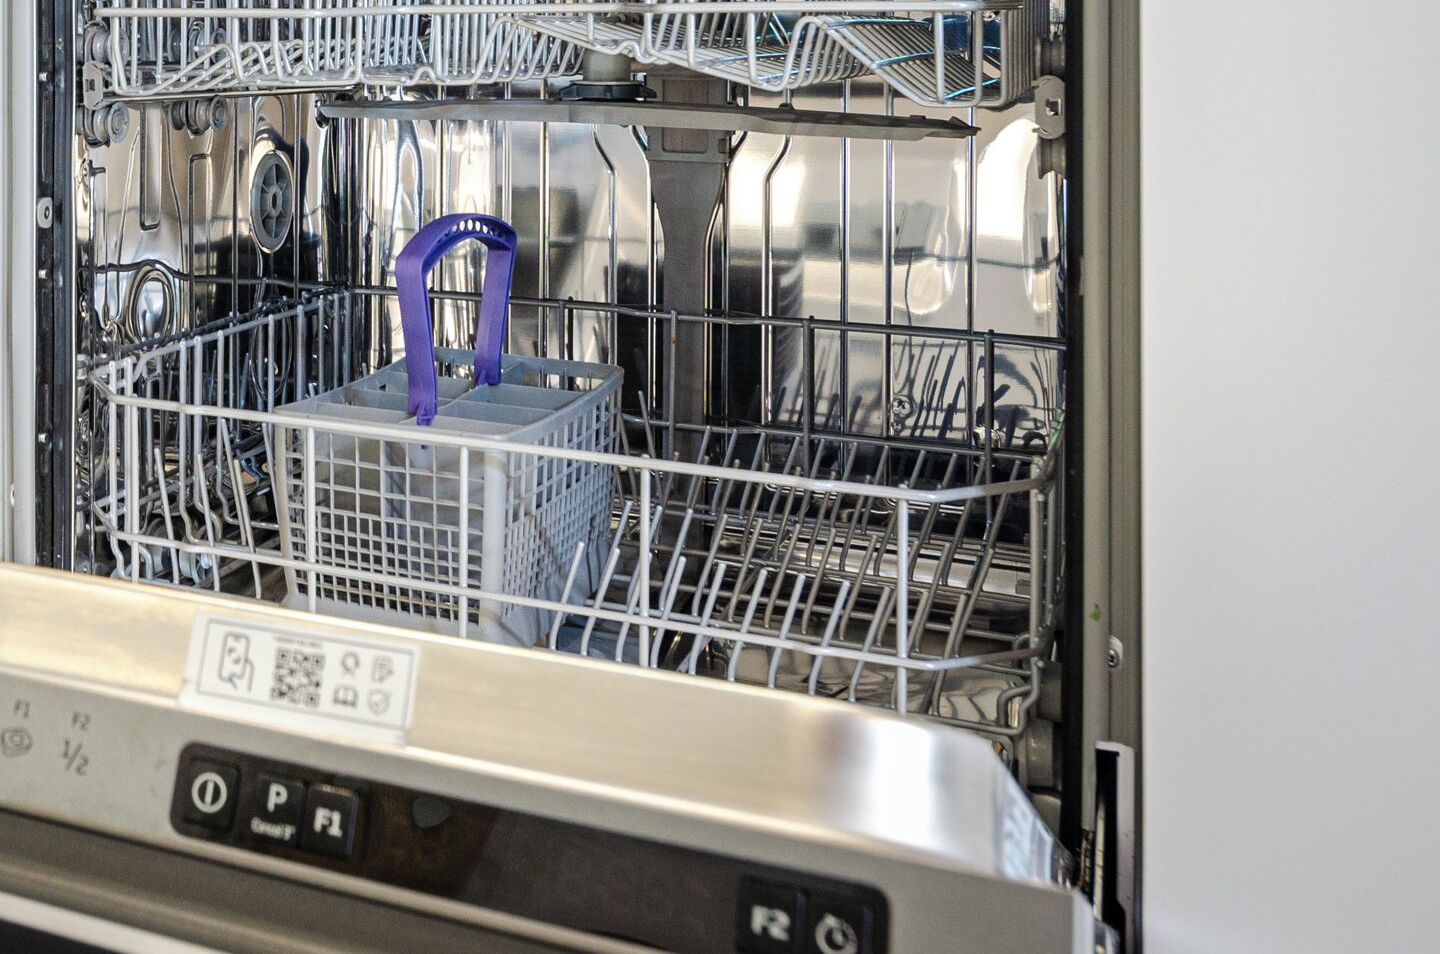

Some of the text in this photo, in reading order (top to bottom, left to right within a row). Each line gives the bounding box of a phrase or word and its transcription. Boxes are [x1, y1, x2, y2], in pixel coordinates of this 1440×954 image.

[13, 699, 30, 719] F1
[71, 710, 91, 732] F2
[62, 738, 89, 776] 1/2
[266, 782, 288, 812] P
[313, 806, 342, 838] F1
[750, 904, 791, 942] F2
